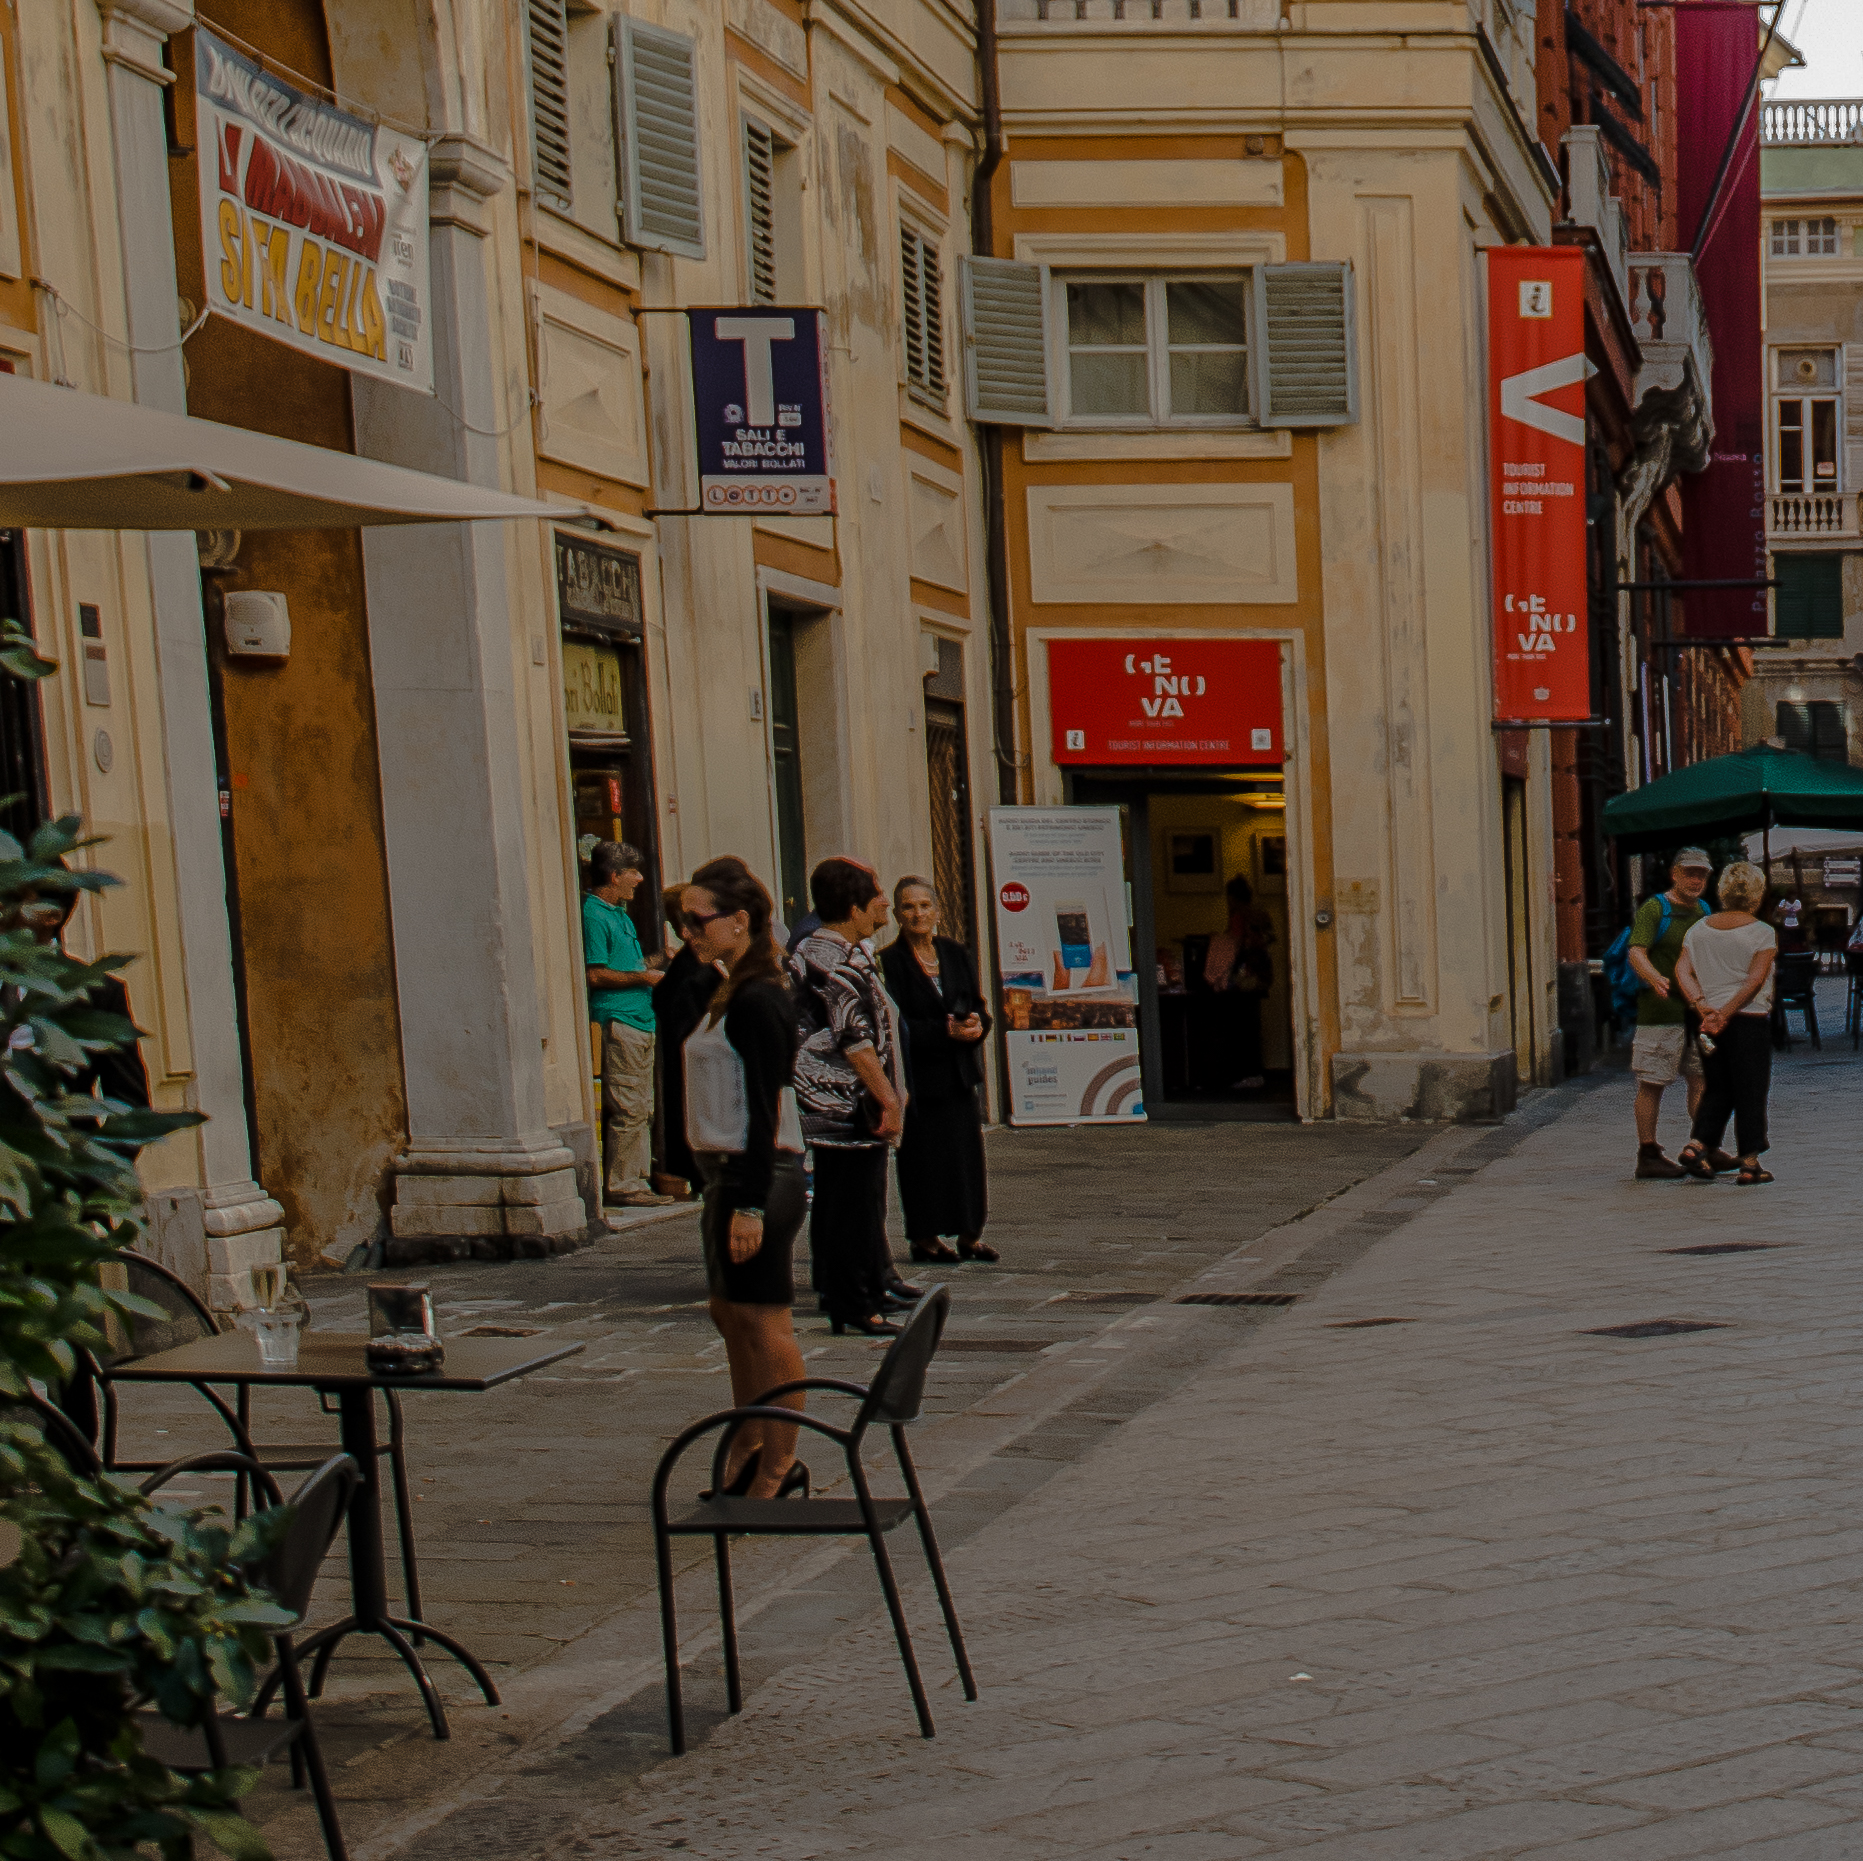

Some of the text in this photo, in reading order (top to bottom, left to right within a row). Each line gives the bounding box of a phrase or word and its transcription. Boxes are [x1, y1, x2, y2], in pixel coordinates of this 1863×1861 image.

[218, 197, 254, 311] SI
[251, 216, 295, 329] FA
[295, 238, 388, 363] BELLA
[715, 317, 795, 427] T
[735, 428, 786, 441] SALI E
[722, 441, 804, 456] TABACCHI
[722, 458, 805, 469] VALORI BOLLATI
[1503, 462, 1545, 476] TOURIST
[1503, 482, 1574, 495] INFORMATION
[1503, 500, 1542, 514] CENTRE
[1751, 530, 1766, 612] Paazzo
[1518, 633, 1556, 652] VA
[1141, 697, 1185, 718] VA
[1108, 740, 1230, 751] TOURIST INFORMATION CENTRE
